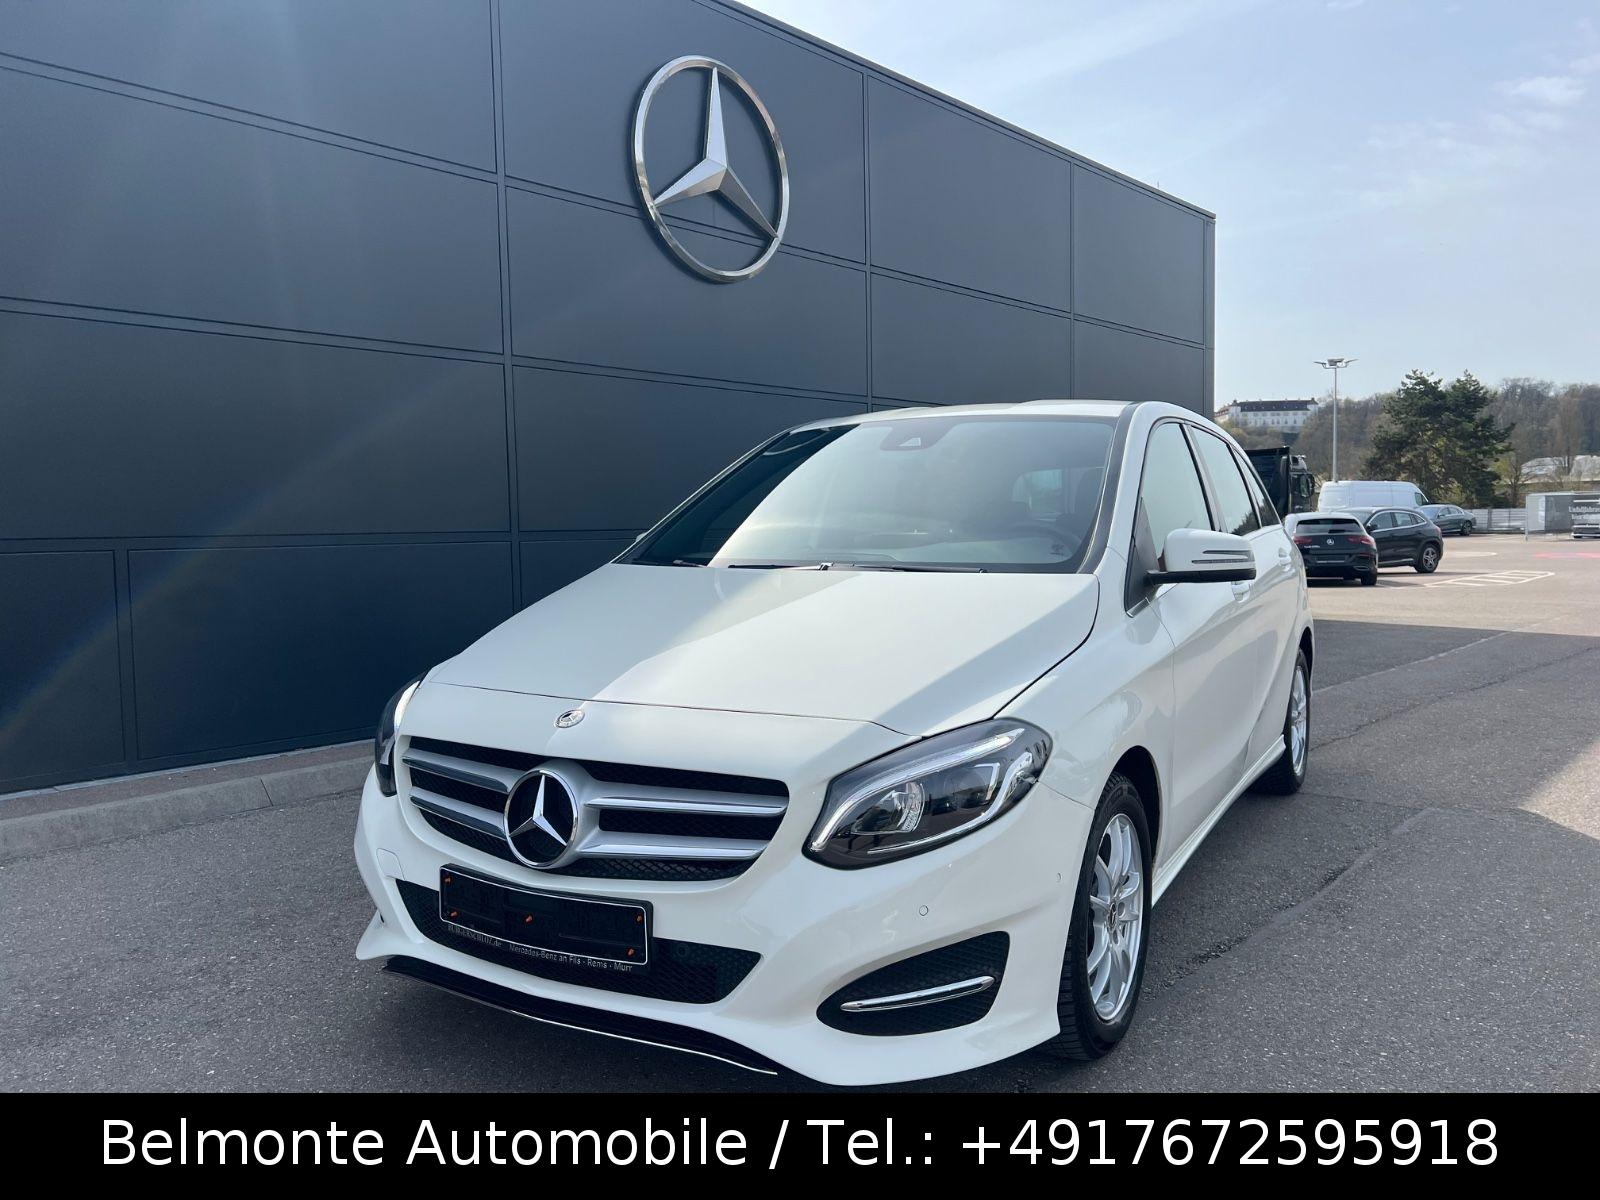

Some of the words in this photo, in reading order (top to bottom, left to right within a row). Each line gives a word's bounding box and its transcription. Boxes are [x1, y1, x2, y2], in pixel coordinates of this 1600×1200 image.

[509, 943, 557, 960] Mercedes-Benz
[559, 954, 567, 962] an
[587, 958, 607, 969] Rems
[613, 962, 633, 972] Murr
